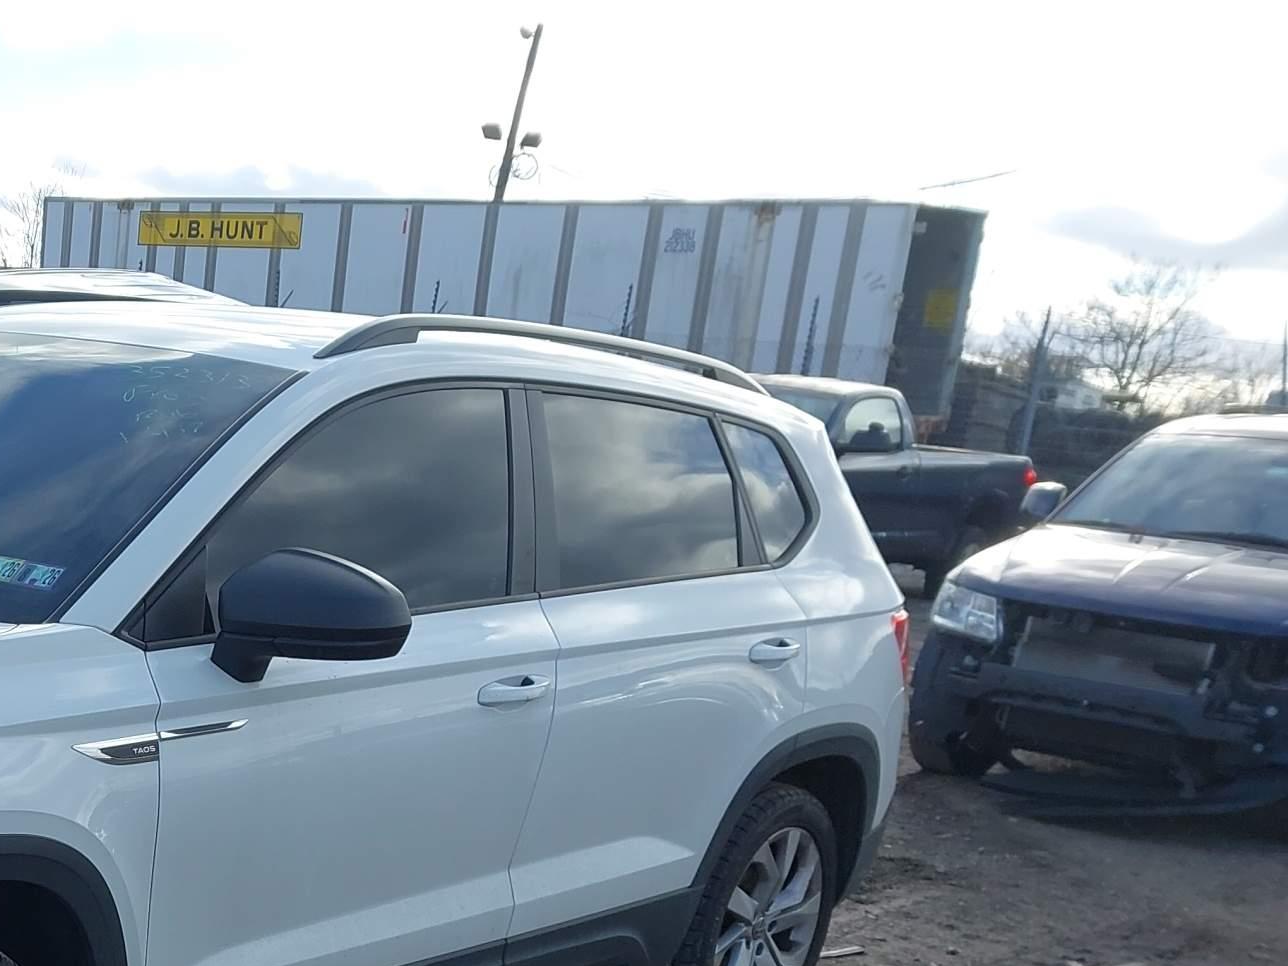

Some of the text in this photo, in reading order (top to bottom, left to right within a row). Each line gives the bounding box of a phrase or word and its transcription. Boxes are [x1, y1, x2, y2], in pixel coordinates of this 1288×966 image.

[169, 219, 268, 240] J.B. HUNT
[133, 745, 156, 755] TAOS
